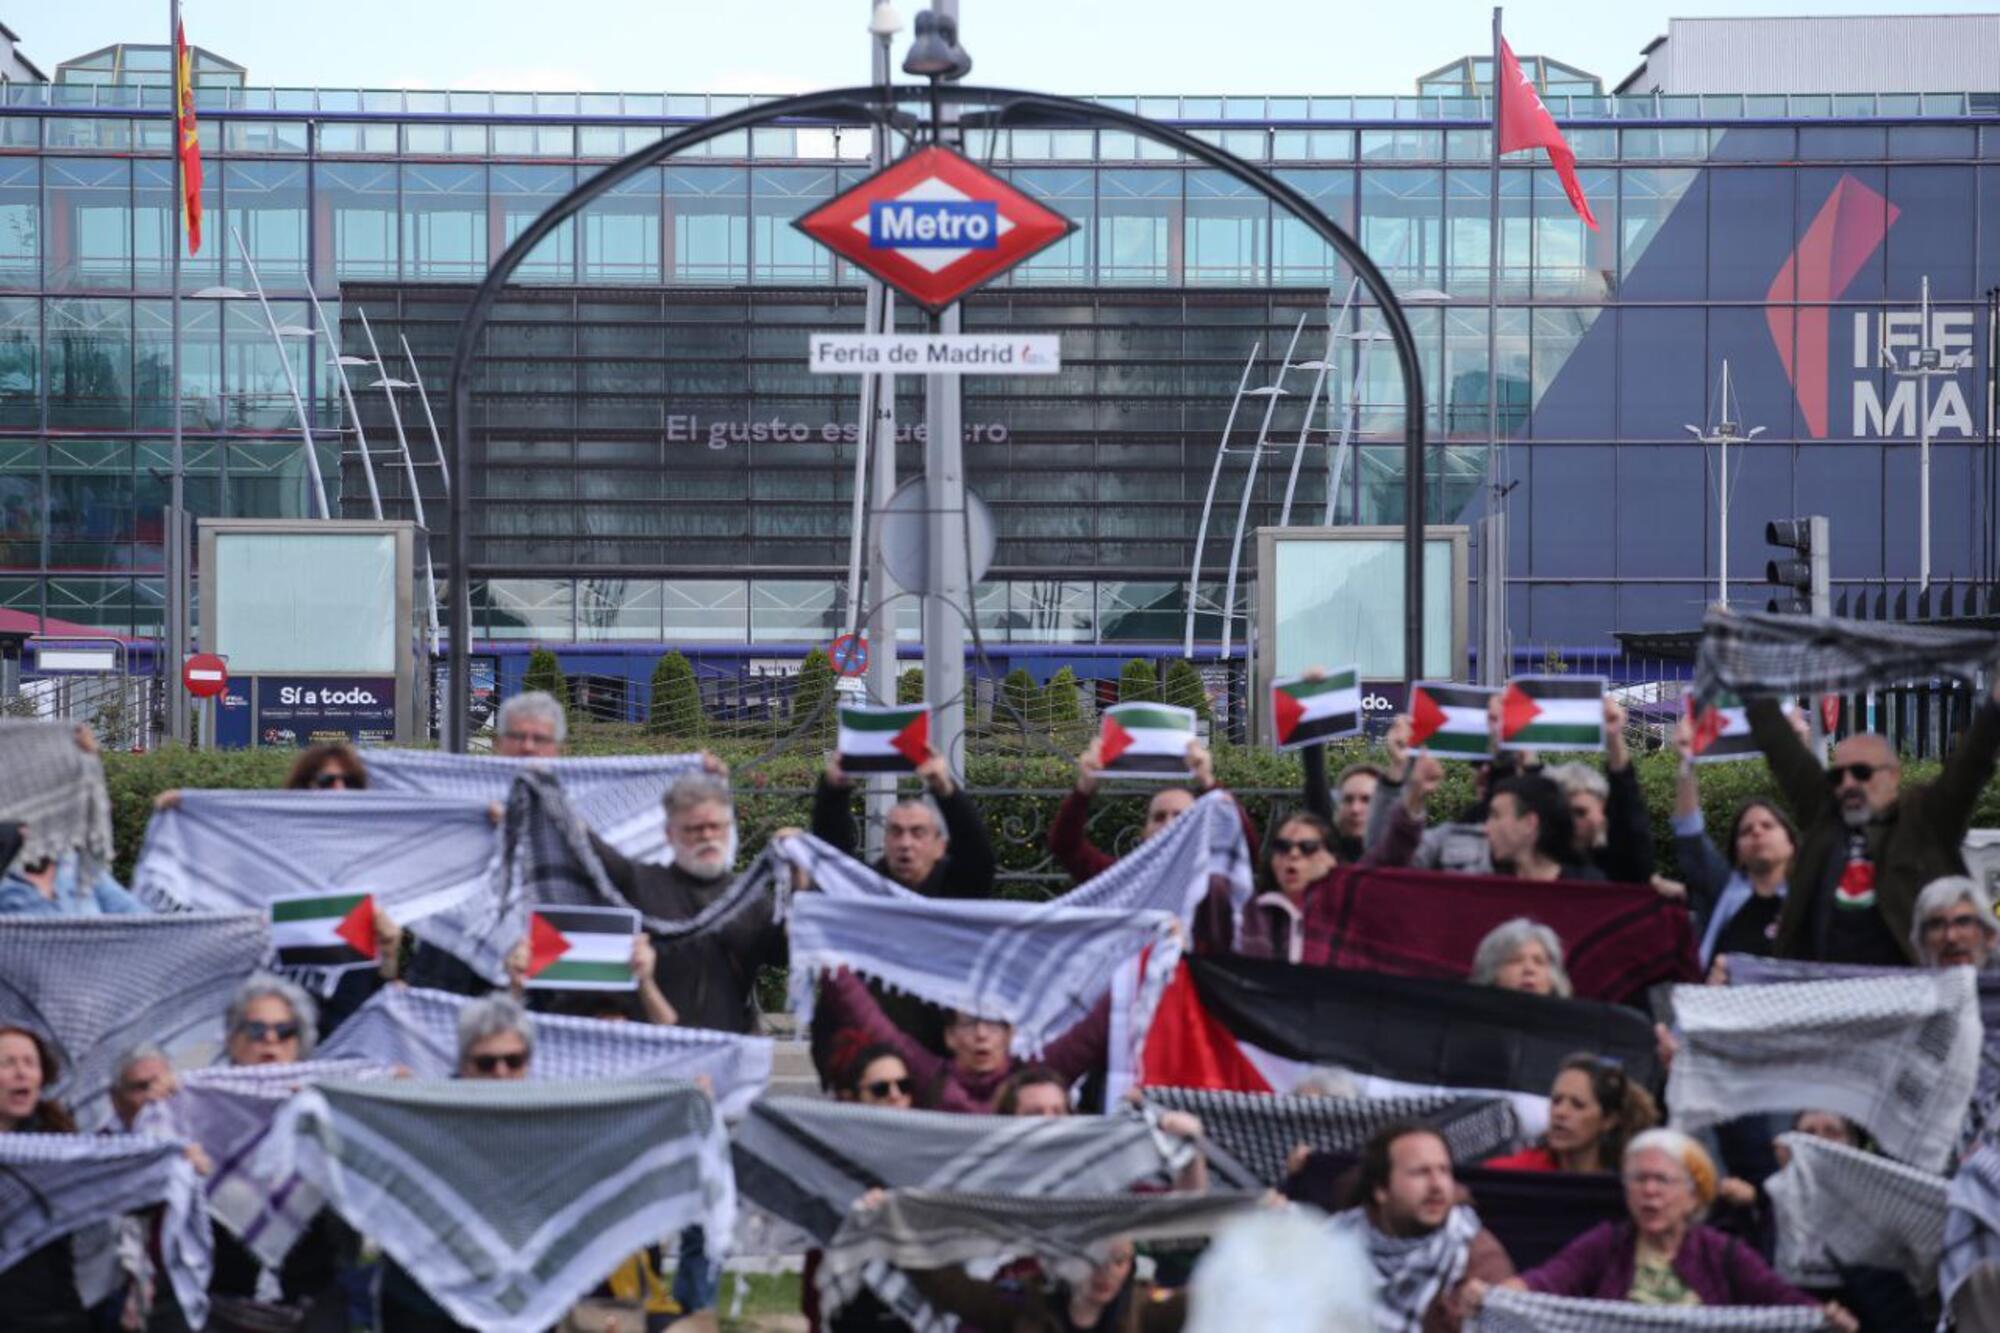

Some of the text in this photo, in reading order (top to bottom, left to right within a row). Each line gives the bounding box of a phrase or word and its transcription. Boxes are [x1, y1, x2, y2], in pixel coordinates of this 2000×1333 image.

[880, 207, 989, 240] Metro
[819, 343, 879, 363] Feria
[887, 343, 918, 363] de
[926, 343, 1013, 363] Madrid
[1854, 312, 1974, 368] IFE
[1853, 381, 1973, 437] MA
[666, 415, 697, 441] El
[707, 416, 810, 450] gusto
[821, 422, 859, 442] es
[280, 686, 378, 704] Sí a todo.
[1362, 692, 1393, 710] do.
